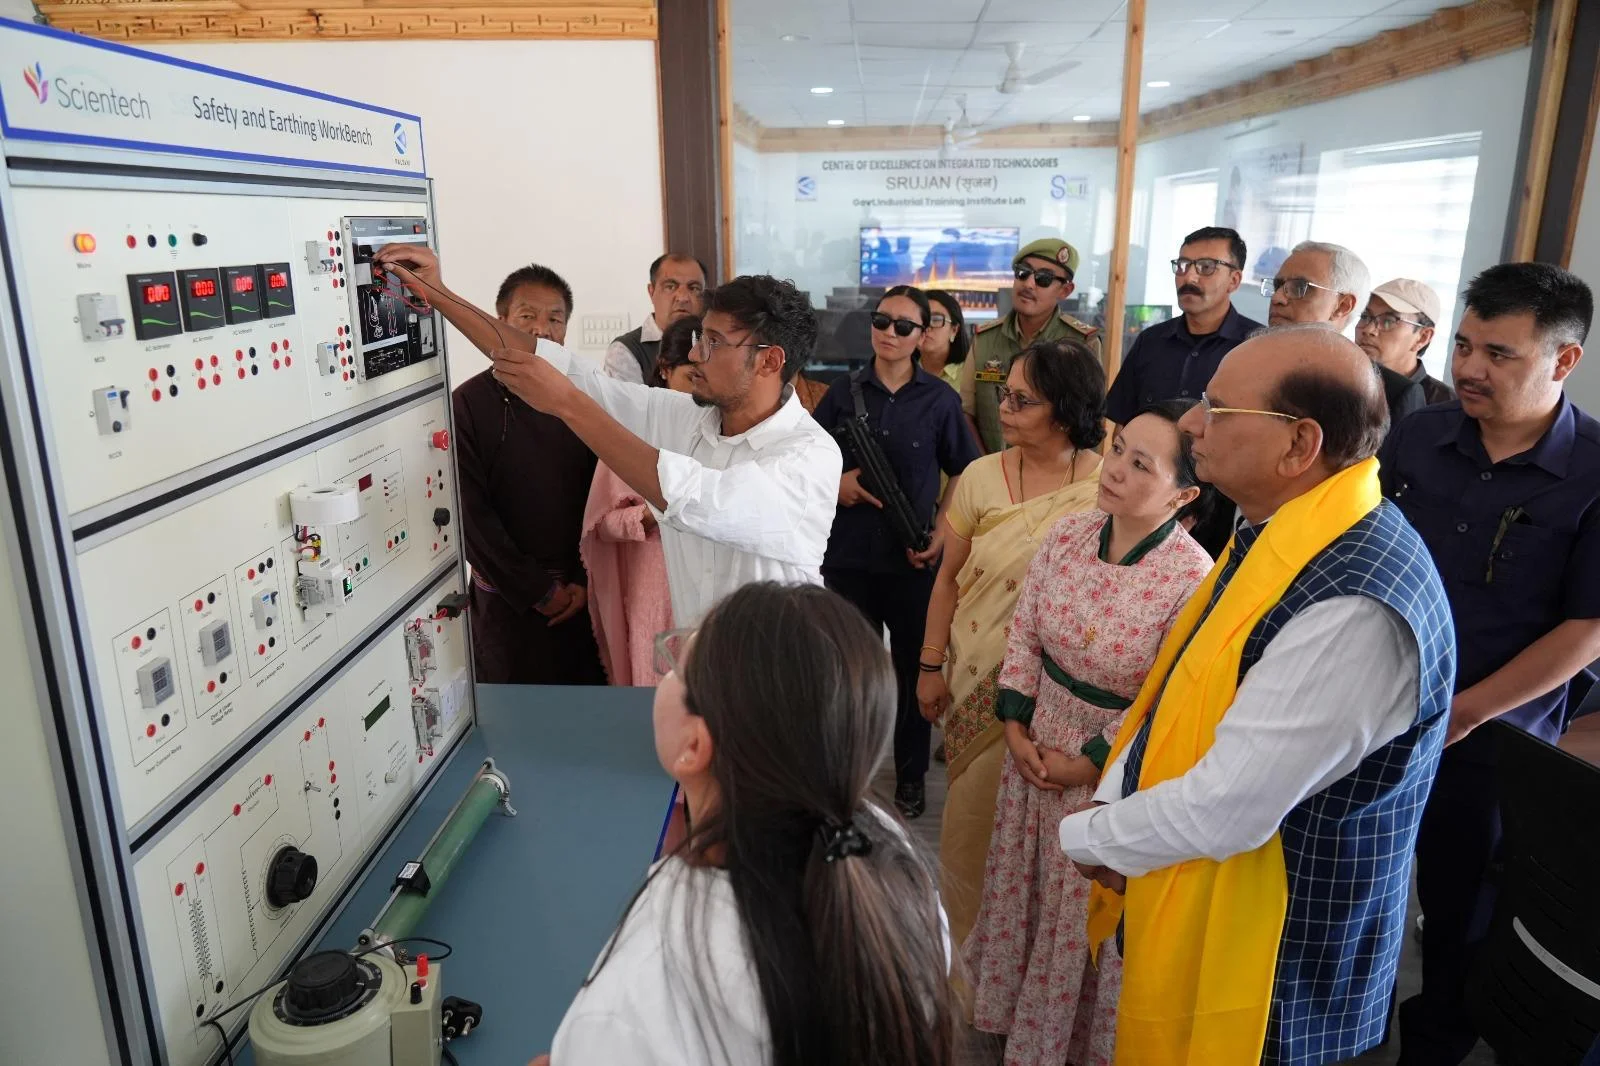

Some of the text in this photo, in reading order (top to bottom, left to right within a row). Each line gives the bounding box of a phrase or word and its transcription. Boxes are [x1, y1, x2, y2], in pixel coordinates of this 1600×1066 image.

[55, 77, 151, 120] Scientech
[192, 95, 373, 146] Safety and Earthing WorkBench
[821, 156, 1059, 171] CENTRE OF EXCELLENCE ON INTEGRATED TECHNOLOGIES
[885, 176, 951, 191] SRUJAN
[925, 197, 966, 207] Training
[966, 196, 1007, 206] Institute
[1009, 196, 1026, 205] Leh
